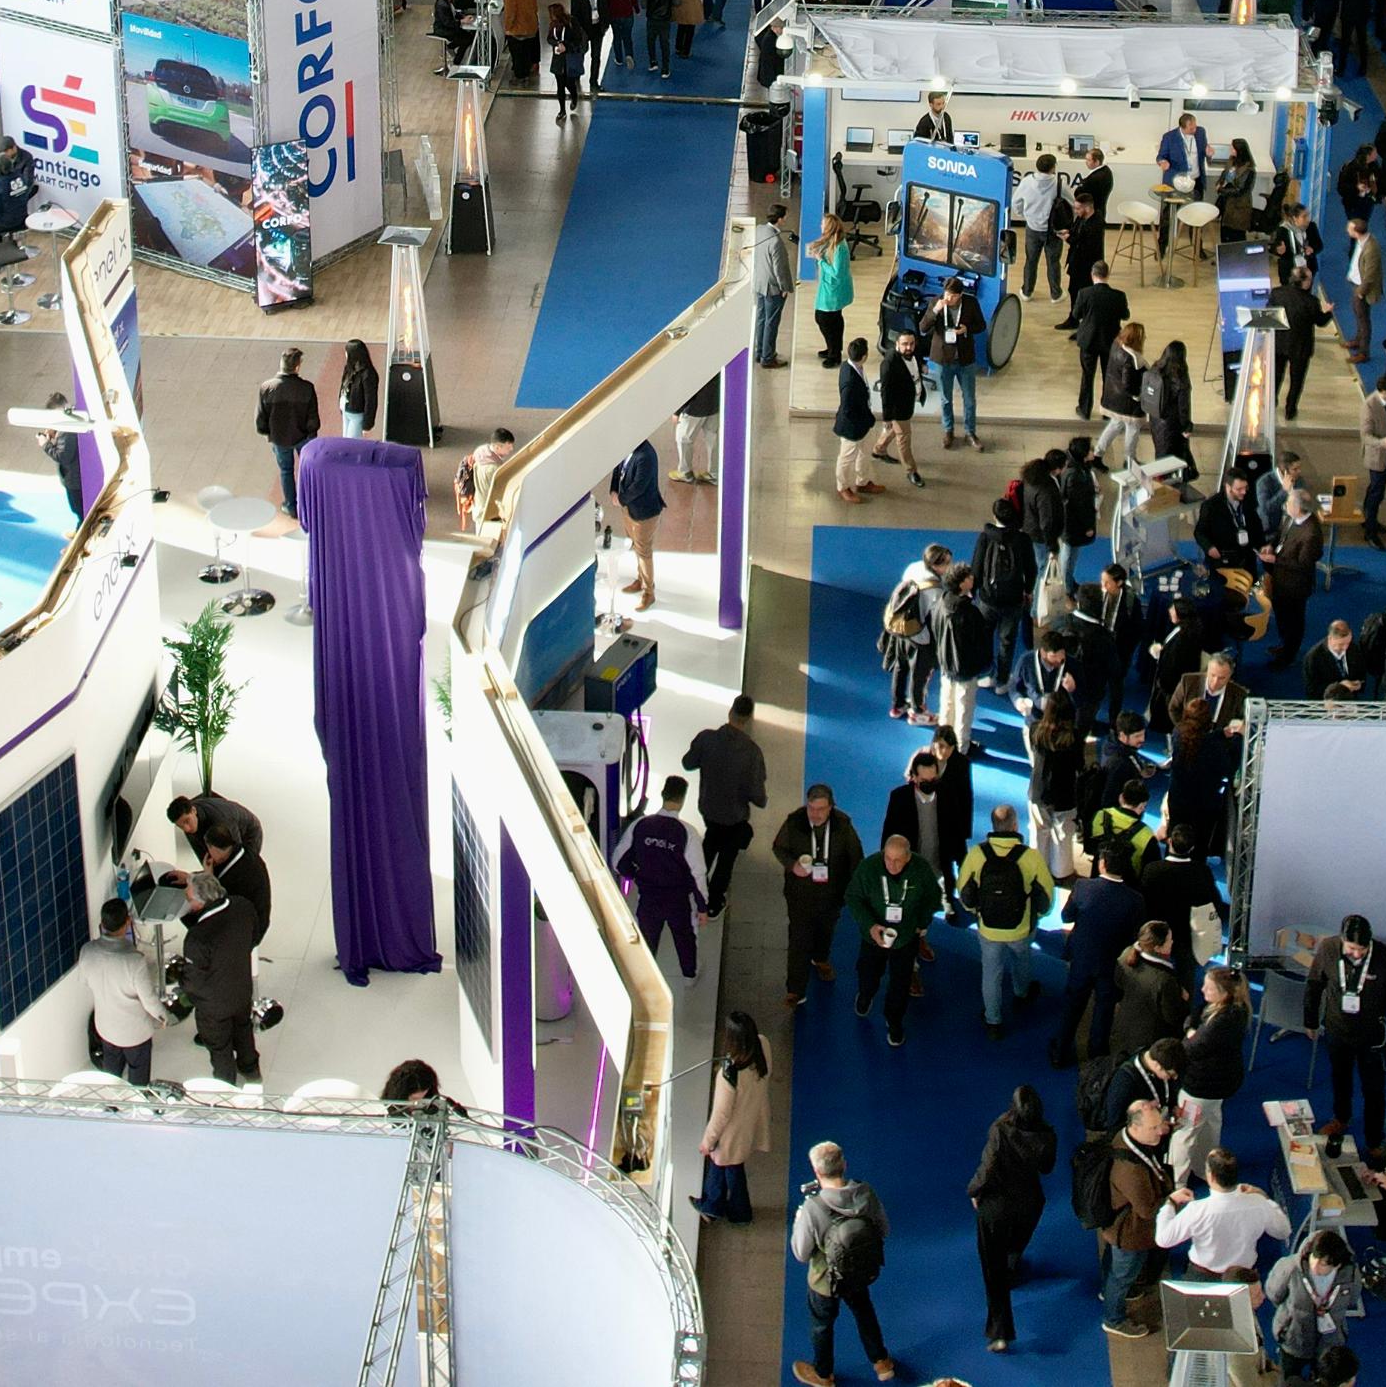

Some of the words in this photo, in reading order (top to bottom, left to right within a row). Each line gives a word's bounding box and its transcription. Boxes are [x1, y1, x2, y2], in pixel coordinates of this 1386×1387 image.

[129, 23, 163, 40] Movilidad
[1010, 110, 1091, 123] HIKVISION
[34, 158, 101, 189] antiago
[927, 155, 978, 179] SONDA
[58, 180, 79, 193] CITY
[262, 213, 303, 230] CORFO
[644, 836, 667, 850] enel
